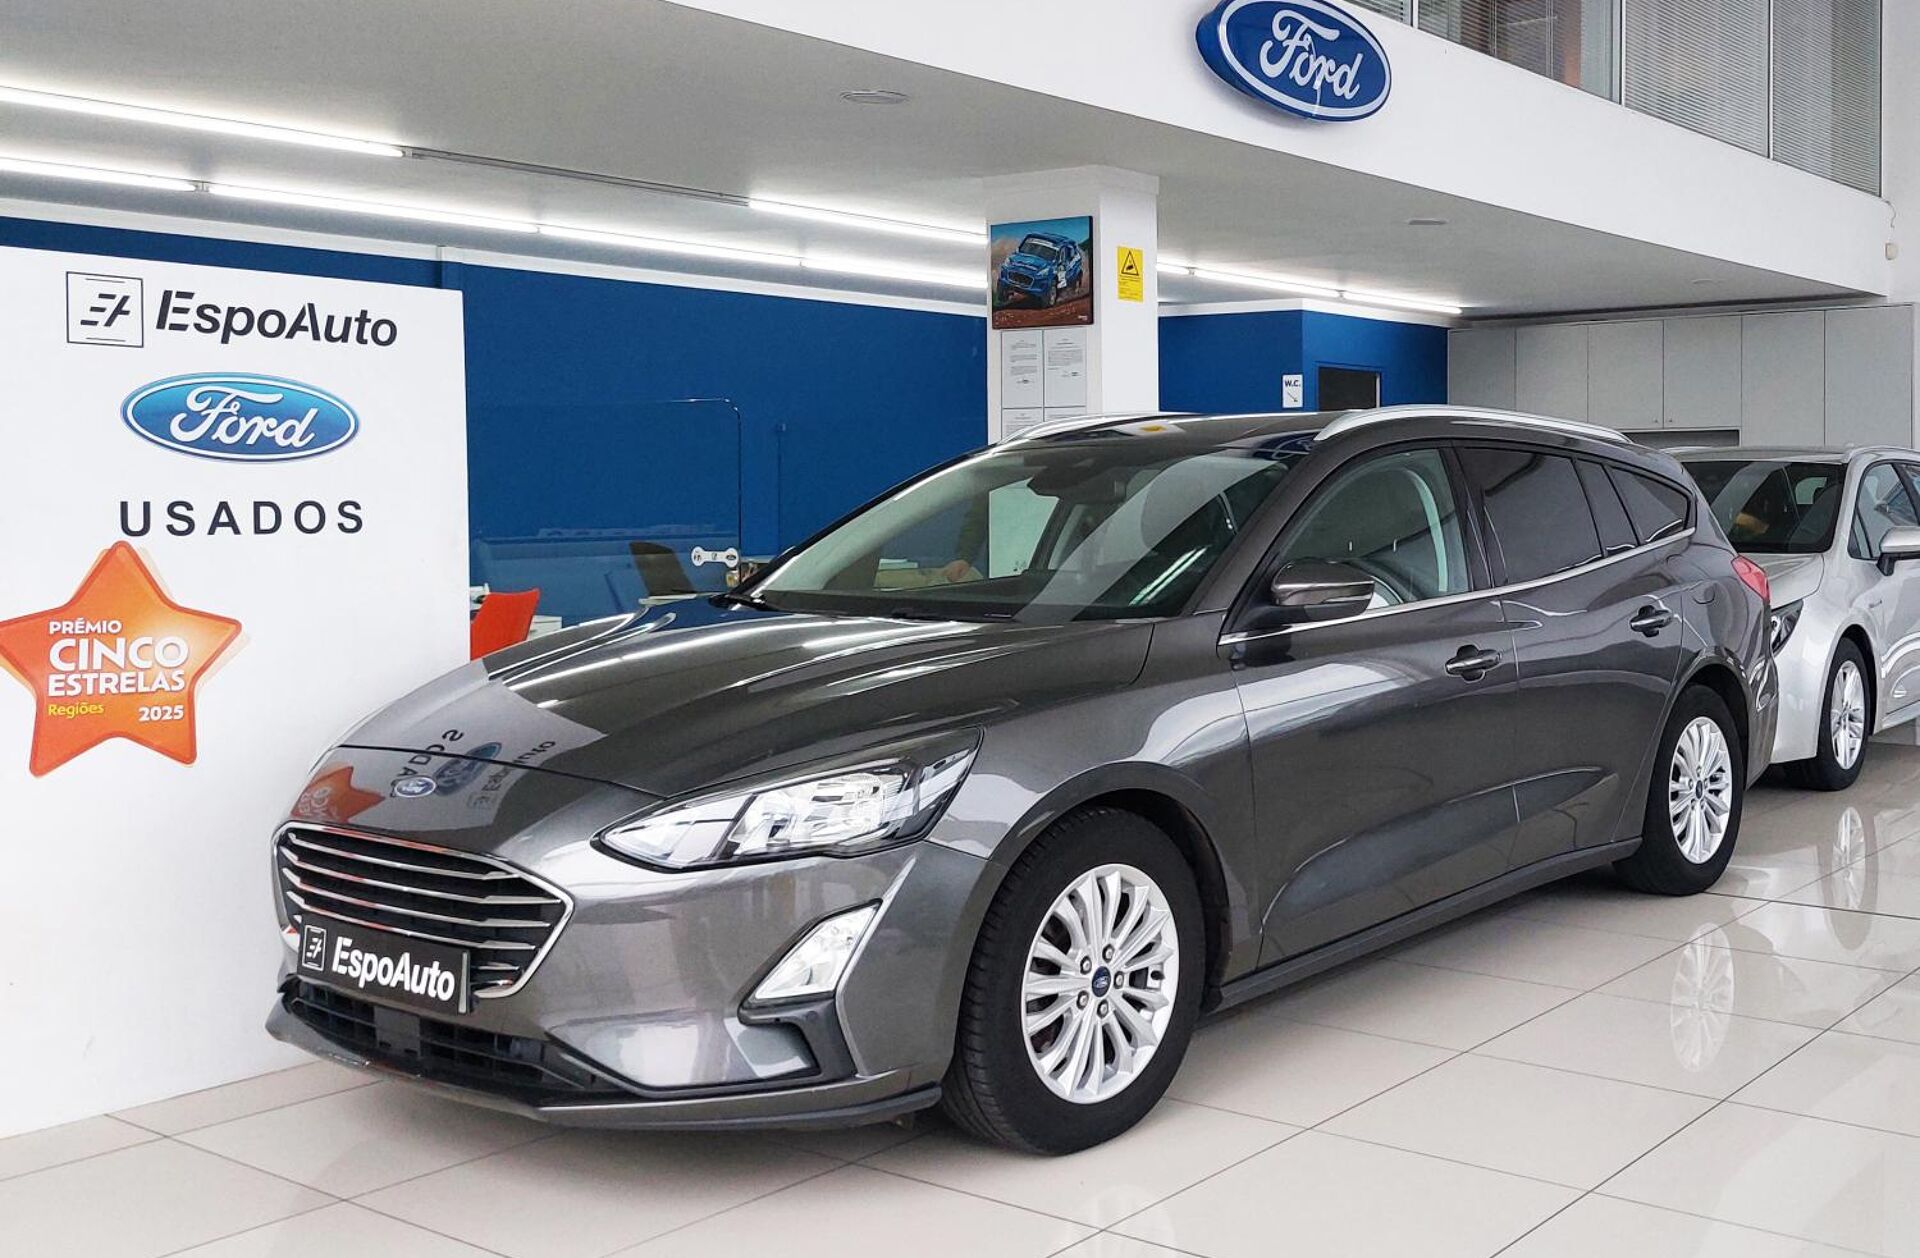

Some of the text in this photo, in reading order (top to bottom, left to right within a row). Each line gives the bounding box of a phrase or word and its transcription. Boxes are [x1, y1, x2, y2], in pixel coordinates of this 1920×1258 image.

[1258, 9, 1364, 100] Ford
[155, 289, 398, 347] EspoAuto
[1284, 379, 1301, 388] W.C.
[169, 384, 321, 450] Ford
[119, 500, 364, 537] USADOS
[49, 617, 123, 635] PRÉMIO
[49, 636, 189, 672] CINCO
[48, 670, 186, 697] ESTRELAS
[48, 701, 185, 723] Regiões 2025
[331, 935, 456, 1001] EspoAuto
